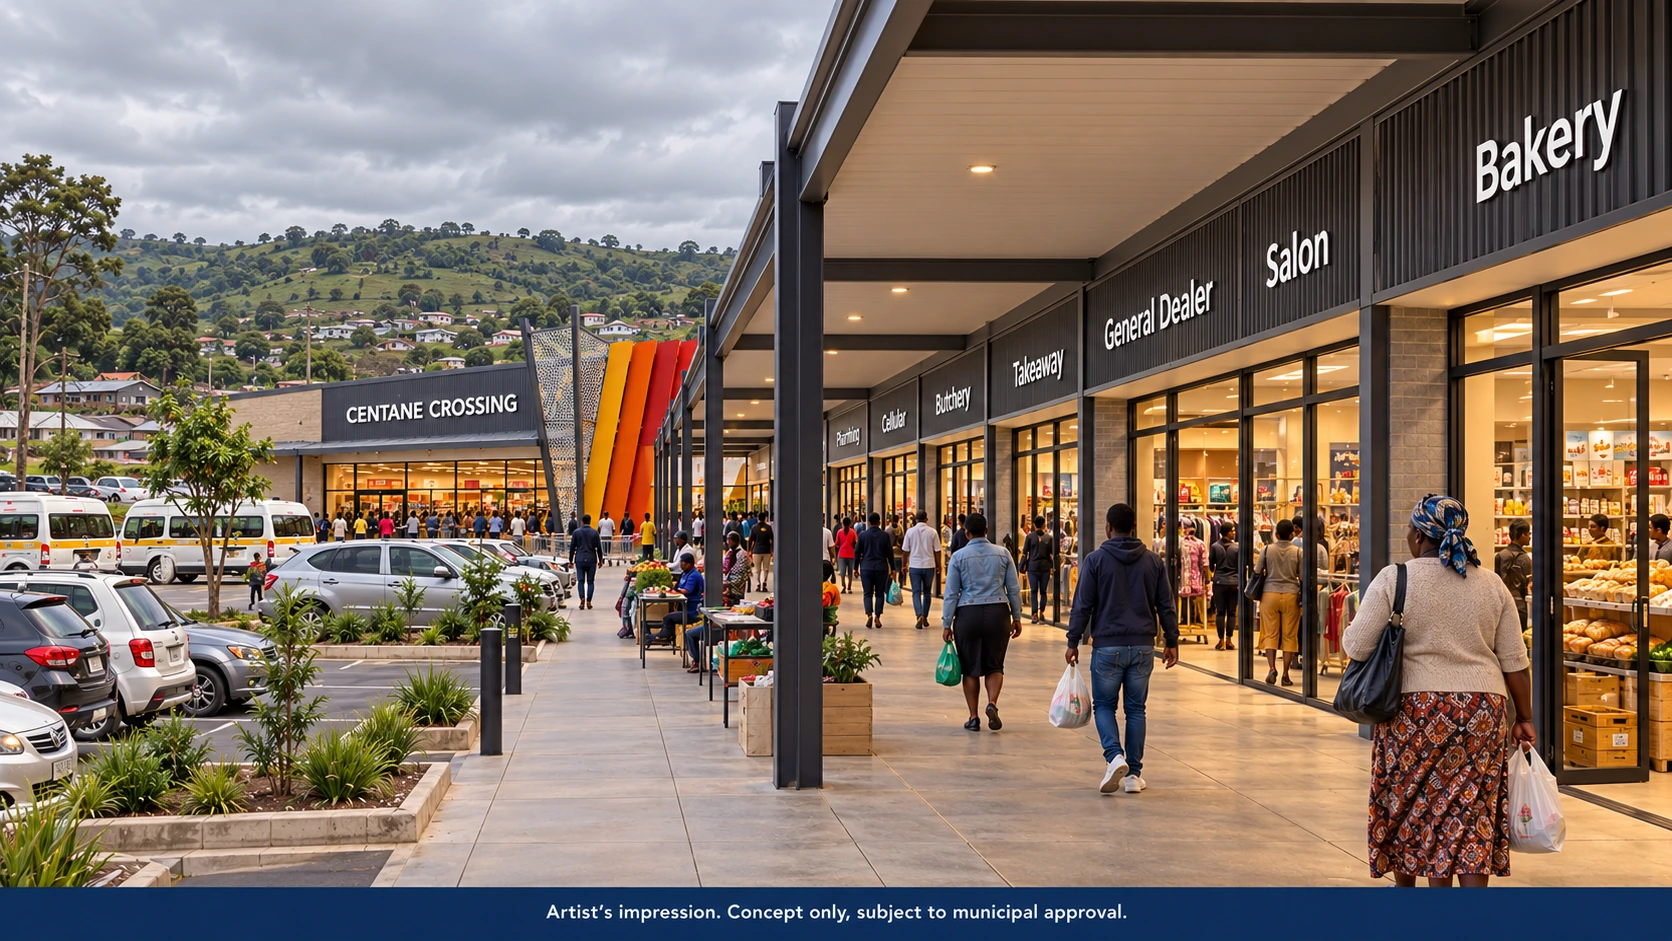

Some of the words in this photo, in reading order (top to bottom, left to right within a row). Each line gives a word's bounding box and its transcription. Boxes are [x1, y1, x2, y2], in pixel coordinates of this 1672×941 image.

[1476, 88, 1624, 204] Bakery
[1265, 229, 1330, 289] Salon
[1104, 296, 1155, 351] General
[1159, 278, 1215, 330] Dealer
[1012, 348, 1065, 388] Takeaway
[345, 401, 424, 424] CENTANE
[428, 393, 518, 419] CROSSING
[935, 385, 972, 416] Butchery
[881, 408, 907, 434] Cellular
